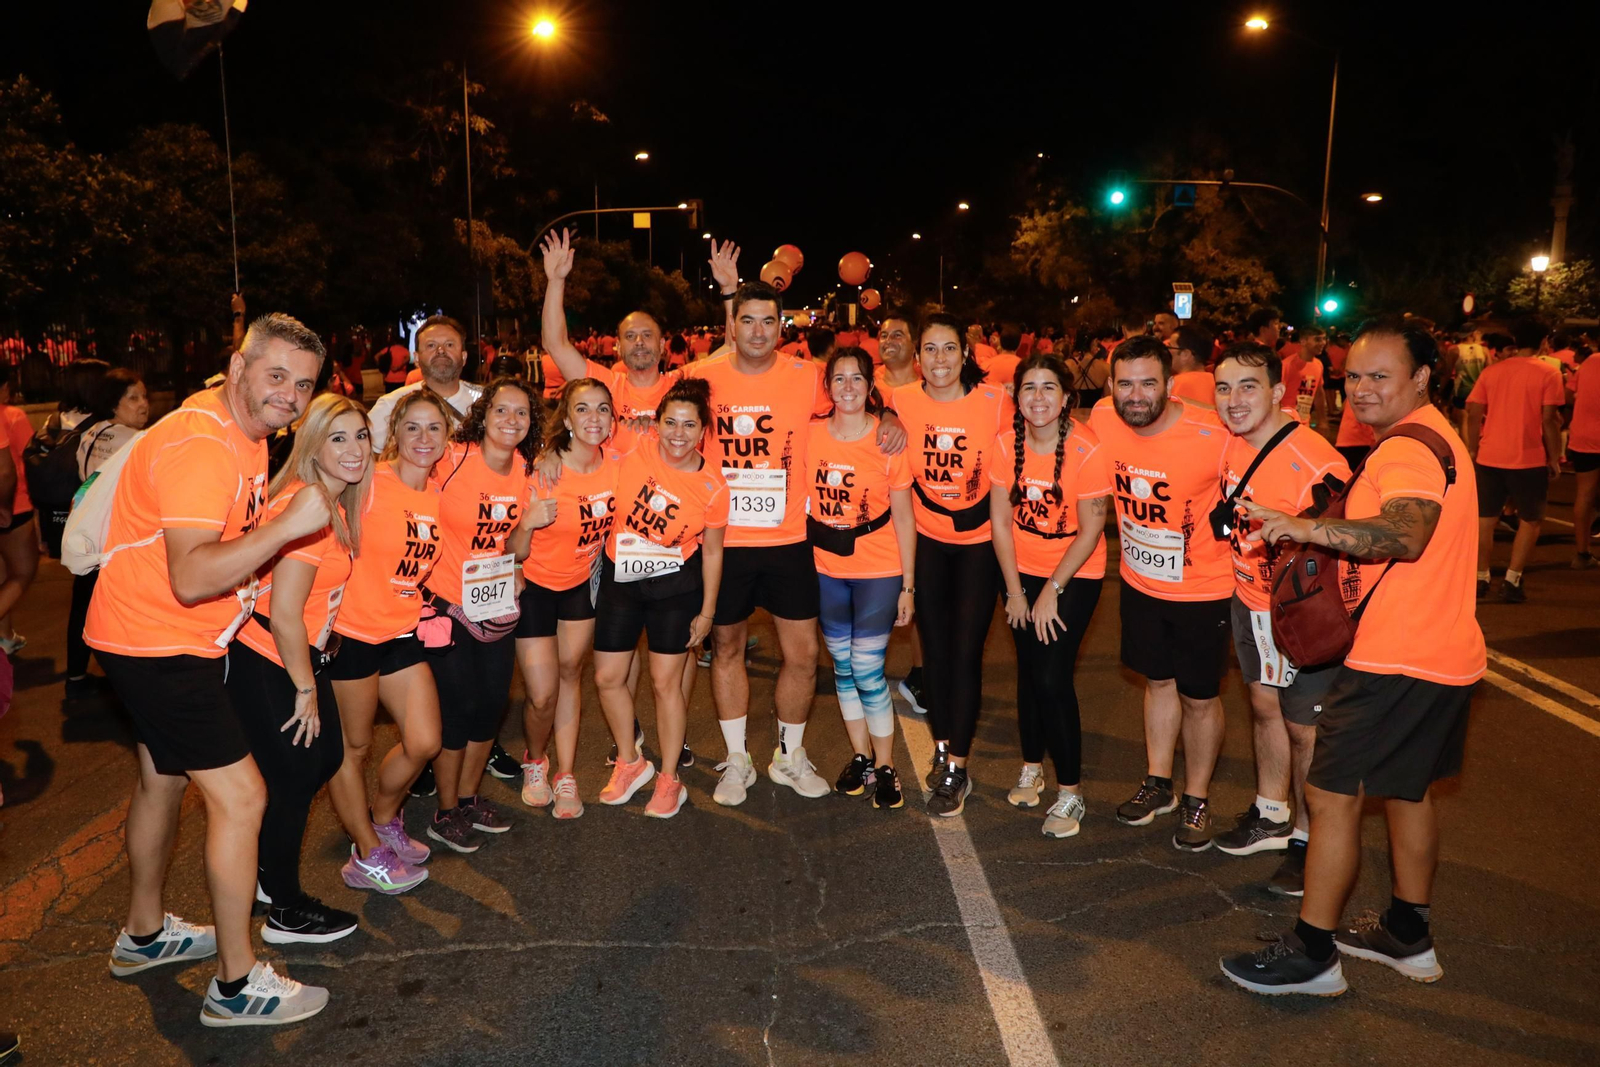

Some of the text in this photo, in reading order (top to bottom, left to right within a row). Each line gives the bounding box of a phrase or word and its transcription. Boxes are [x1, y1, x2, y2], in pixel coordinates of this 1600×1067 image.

[1178, 295, 1188, 307] P
[717, 404, 771, 413] 36 CARRERA
[717, 415, 774, 436] NOC
[925, 424, 935, 432] 36
[719, 438, 770, 457] TUR
[924, 433, 968, 451] NOC
[828, 462, 855, 471] CARRERA
[923, 451, 964, 469] TUR
[815, 469, 855, 488] NOC
[924, 469, 953, 482] NA
[1115, 460, 1167, 479] 36 CARRERA
[480, 492, 490, 501] 36
[578, 490, 613, 503] 36 CARRERA
[646, 476, 681, 504] 36 CARRERA
[815, 486, 851, 503] TUR
[1115, 473, 1172, 502] NOC
[579, 497, 616, 520] NOC
[637, 484, 680, 520] NOC
[731, 496, 776, 512] 1339
[819, 502, 845, 517] NA
[1118, 495, 1168, 524] TUR
[404, 510, 436, 522] 36 CARRERA
[478, 503, 518, 521] NOC
[631, 500, 668, 535] TUR
[1018, 508, 1038, 530] NA
[406, 521, 439, 541] NOC
[476, 522, 511, 535] TUR
[581, 516, 614, 534] TUR
[625, 515, 650, 538] NA
[405, 541, 436, 560] TUR
[471, 536, 496, 551] NA
[1124, 539, 1175, 570] 20991
[395, 559, 419, 577] NA
[471, 582, 507, 604] 9847
